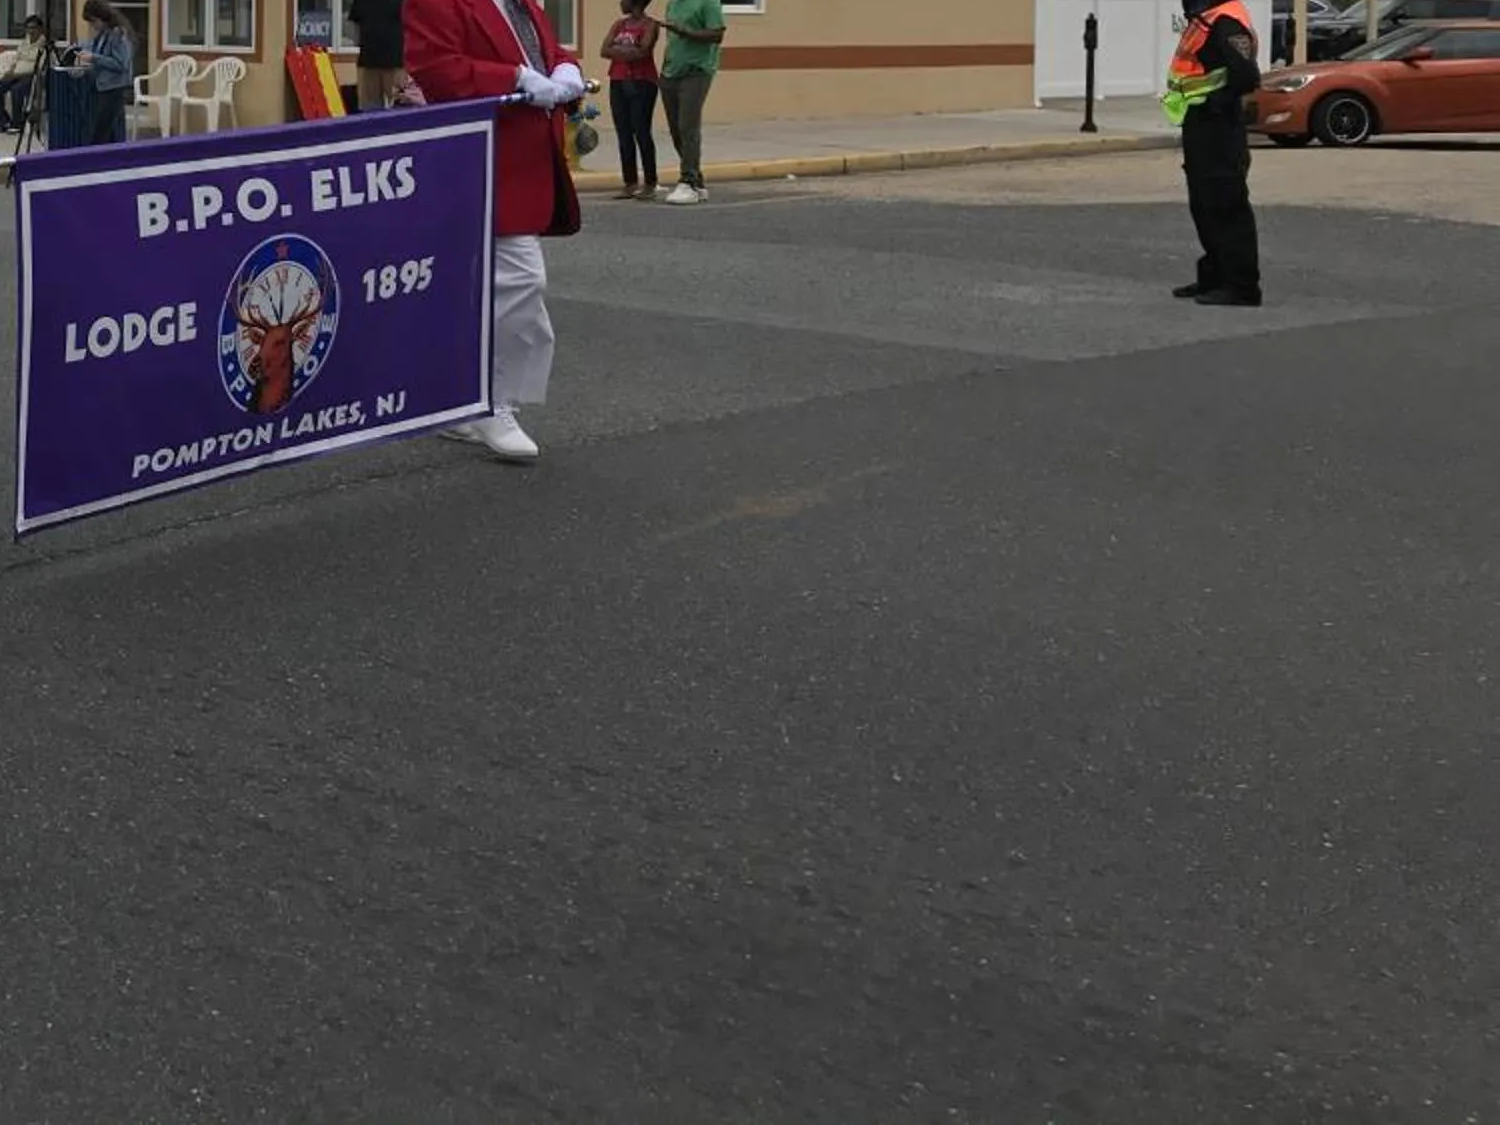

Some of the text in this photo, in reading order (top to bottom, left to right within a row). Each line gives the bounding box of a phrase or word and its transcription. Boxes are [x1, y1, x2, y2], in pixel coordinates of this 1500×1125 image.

[136, 156, 416, 238] B.P.O. ELKS
[362, 256, 435, 304] 1895
[64, 302, 197, 364] LODGE
[131, 390, 407, 479] POMPTON LAKES, NJ
